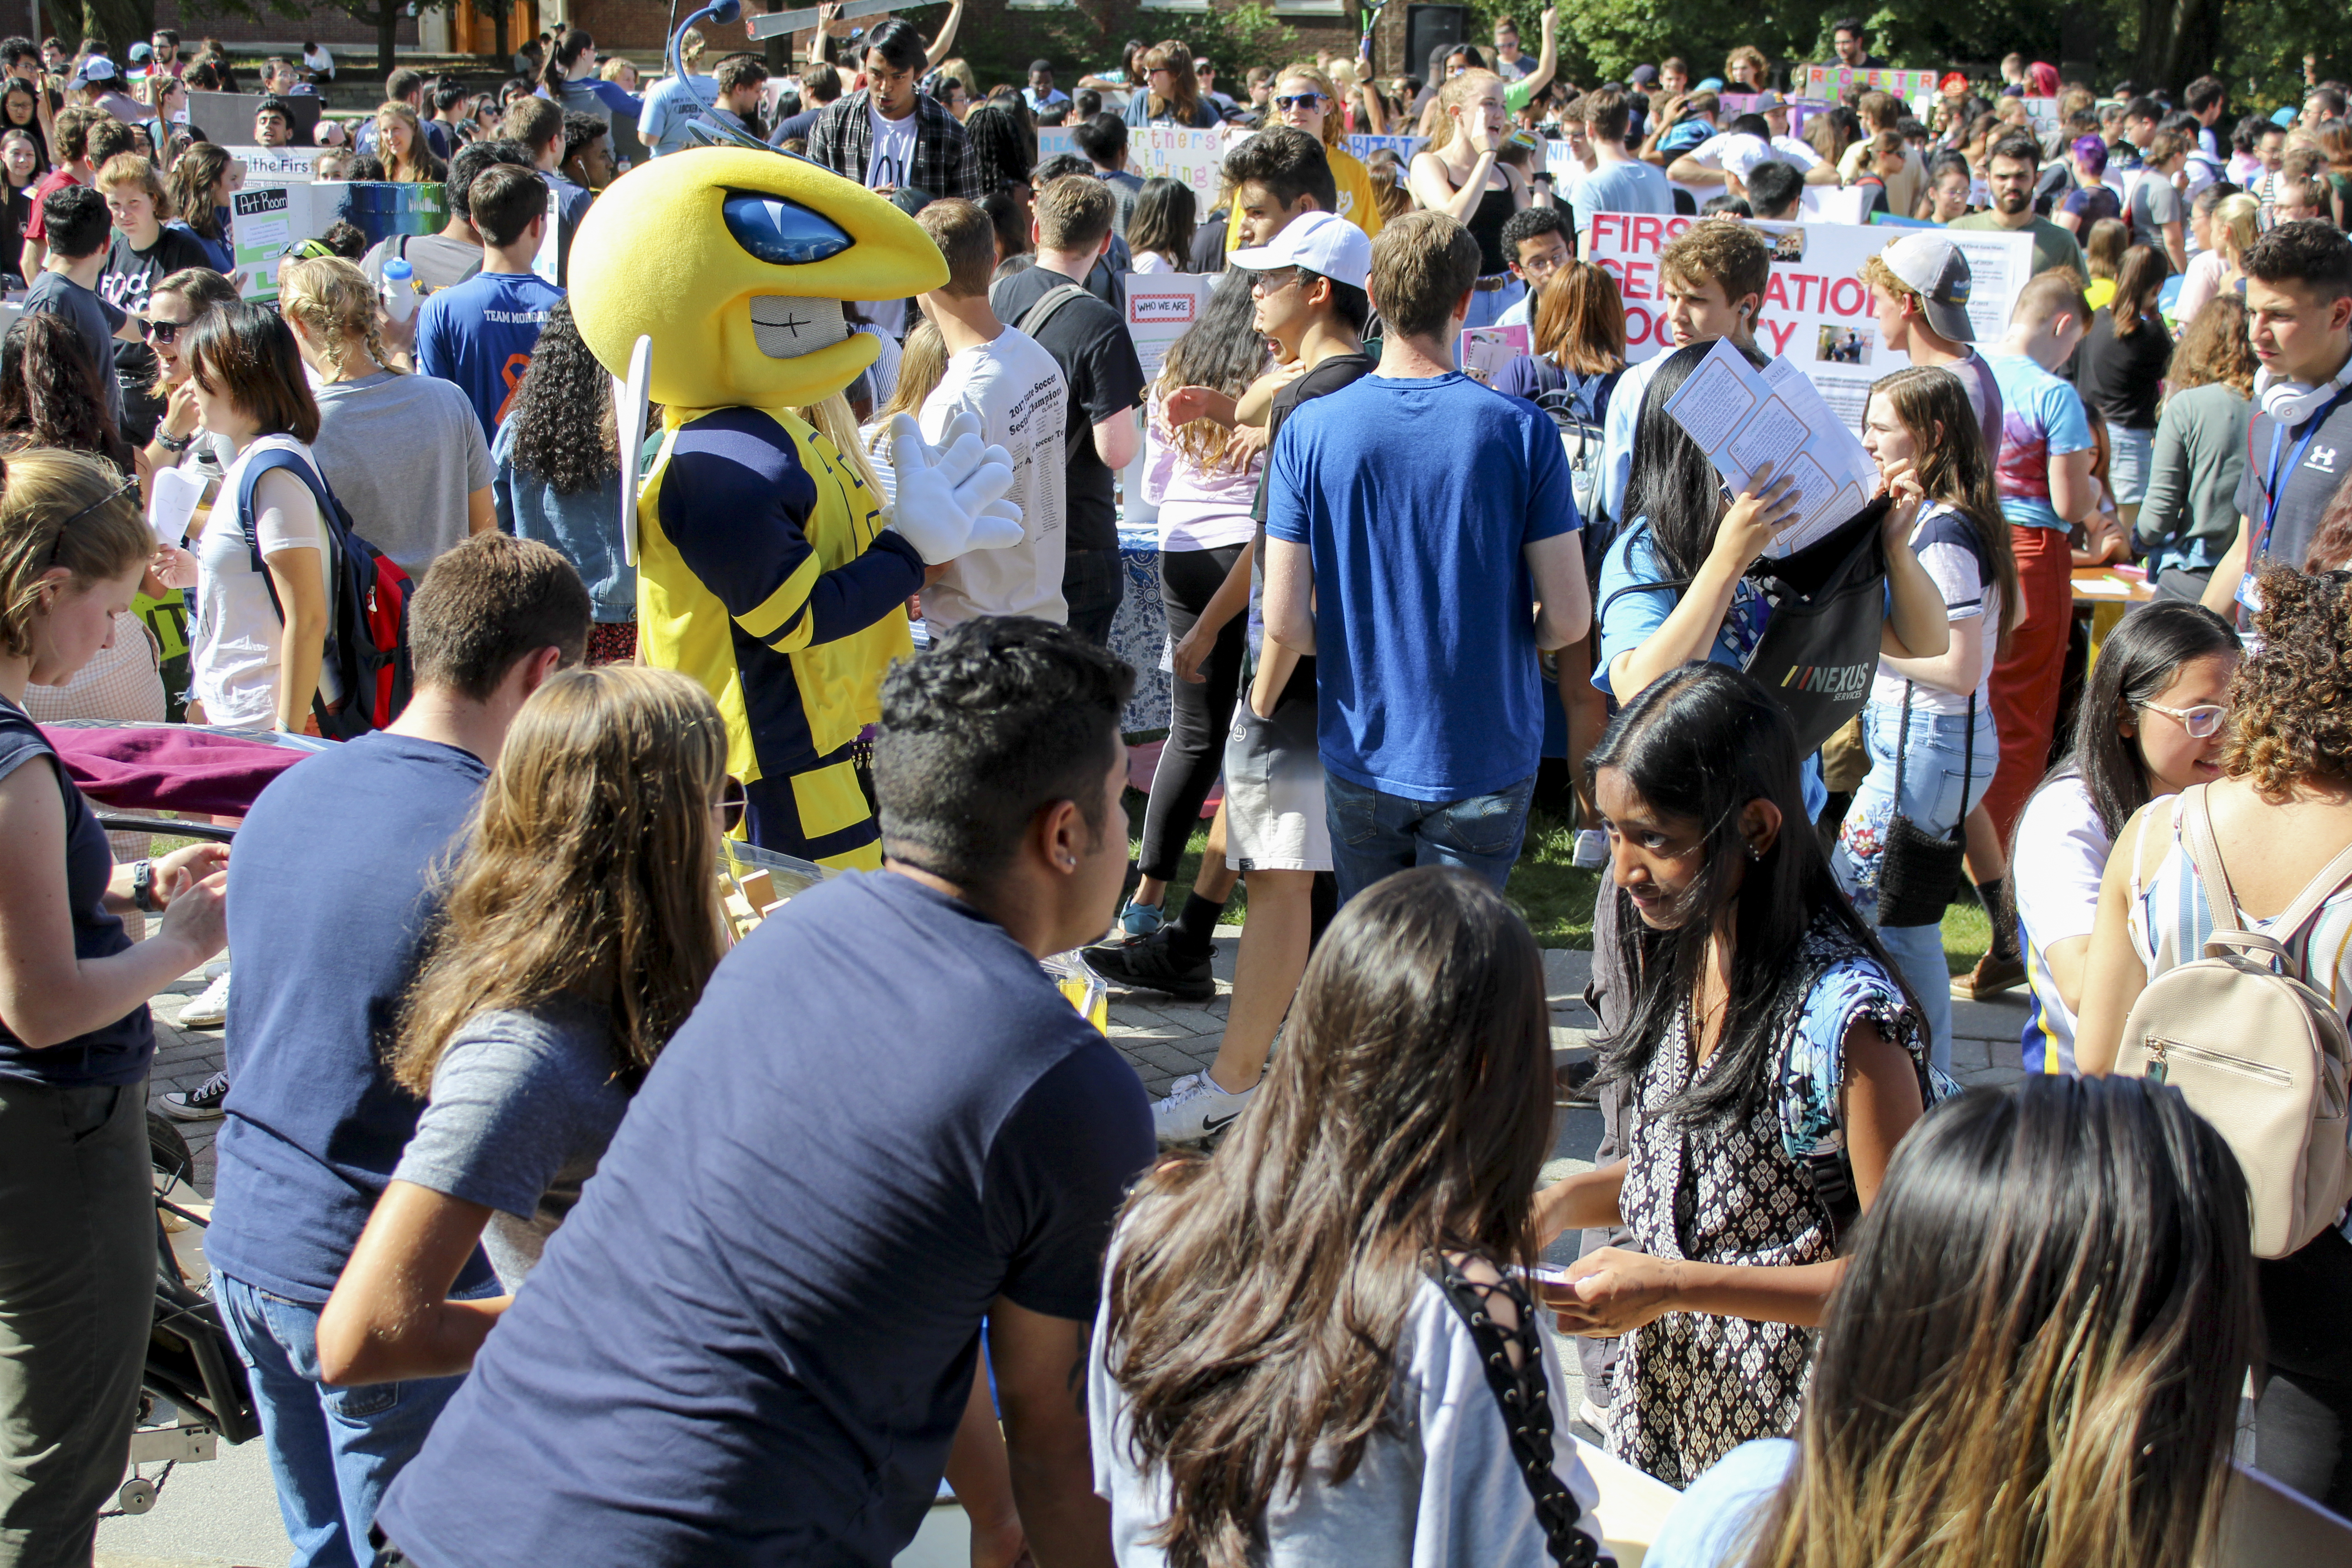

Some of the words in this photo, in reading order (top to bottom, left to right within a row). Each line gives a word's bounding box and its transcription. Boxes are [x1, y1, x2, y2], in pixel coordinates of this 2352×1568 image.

[1811, 69, 1933, 88] ROCHESTER
[253, 158, 277, 171] the
[1144, 148, 1164, 167] in
[240, 194, 260, 214] Art
[260, 191, 288, 211] Room
[1591, 215, 1691, 255] FIRS
[1137, 301, 1156, 312] WHO
[1158, 301, 1170, 310] WE
[1171, 301, 1187, 311] ARE
[484, 310, 510, 323] TEAM
[512, 311, 551, 324] MORGAN
[1009, 400, 1025, 419] 2017
[1034, 373, 1056, 393] Soccer
[1689, 386, 1703, 402] Drama
[1701, 372, 1715, 387] House
[1747, 411, 1769, 437] GreenSpace
[1793, 461, 1804, 473] Floor
[1806, 662, 1869, 693] NEXUS
[1833, 690, 1862, 701] SERVICES
